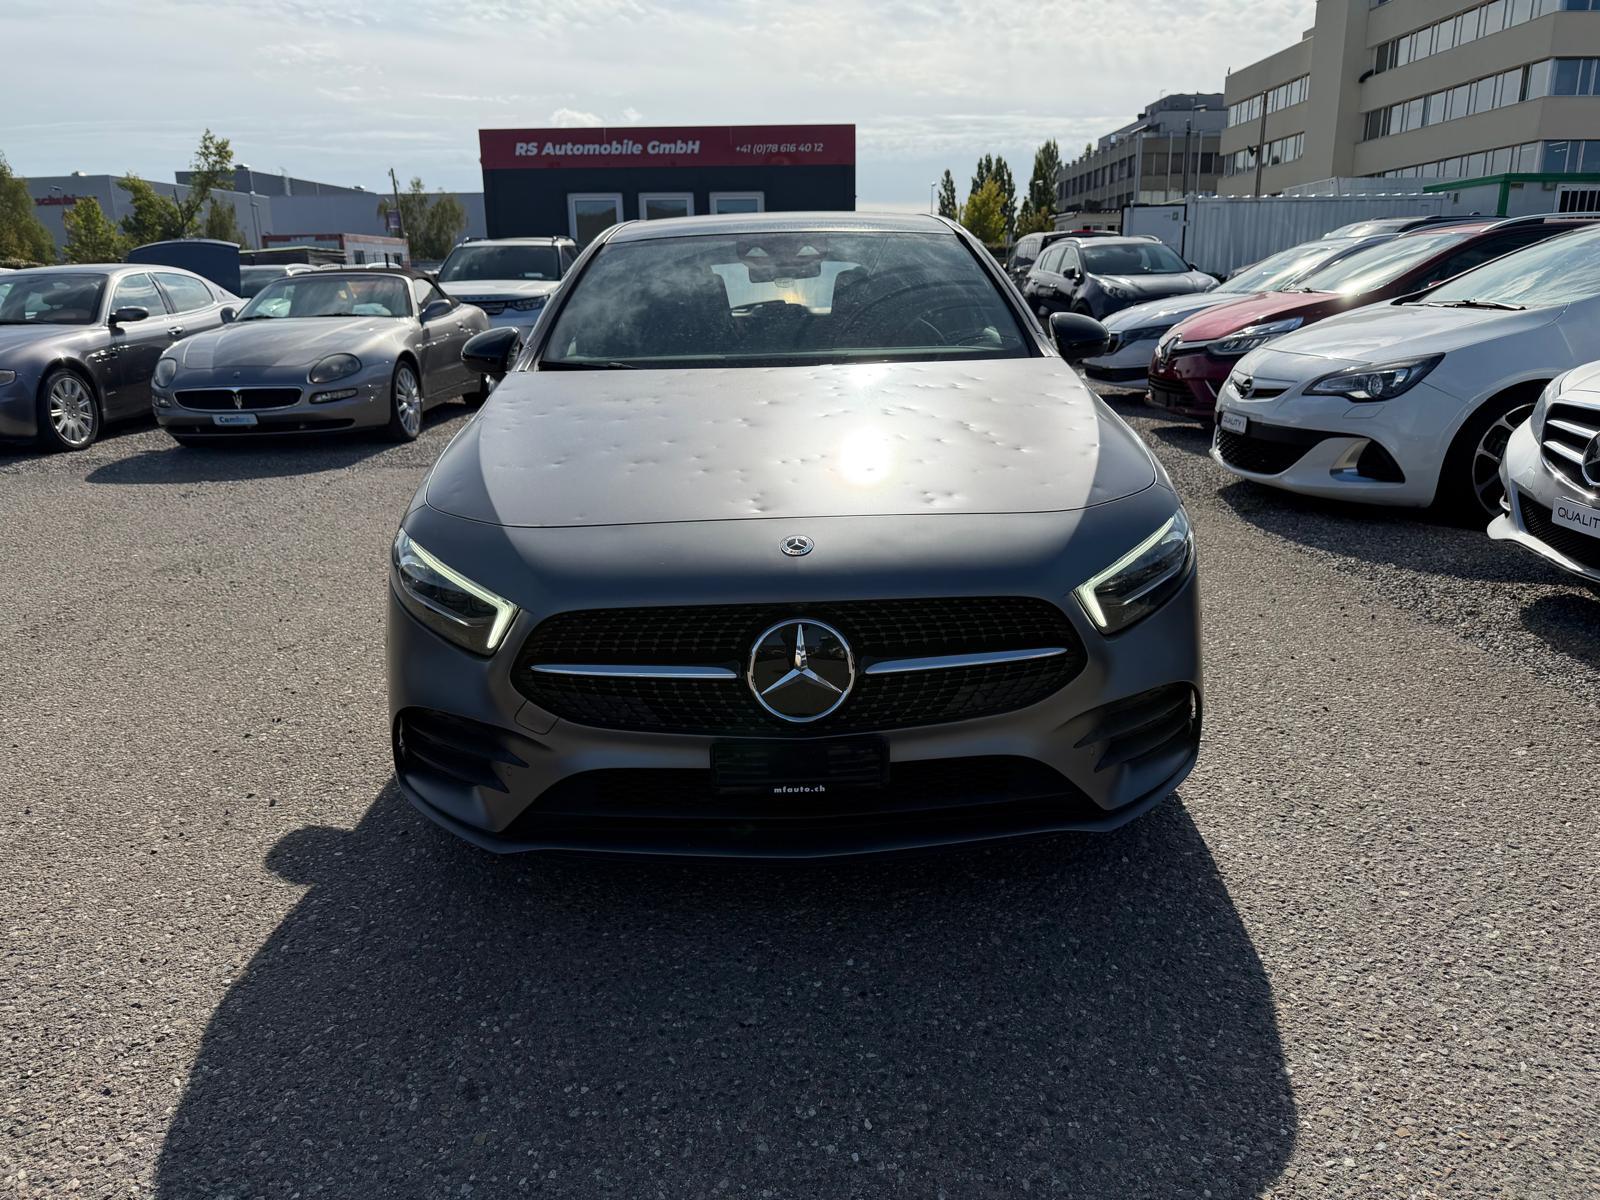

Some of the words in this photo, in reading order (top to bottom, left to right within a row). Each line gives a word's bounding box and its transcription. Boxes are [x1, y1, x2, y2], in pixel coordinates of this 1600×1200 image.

[515, 142, 538, 156] RS
[541, 139, 643, 156] Automobile
[647, 140, 700, 154] GmbH
[736, 144, 752, 153] +41
[753, 143, 778, 155] (0)78
[780, 143, 796, 153] 616
[798, 143, 812, 152] 40
[814, 142, 824, 152] 12
[773, 785, 826, 793] mfauto.ch
